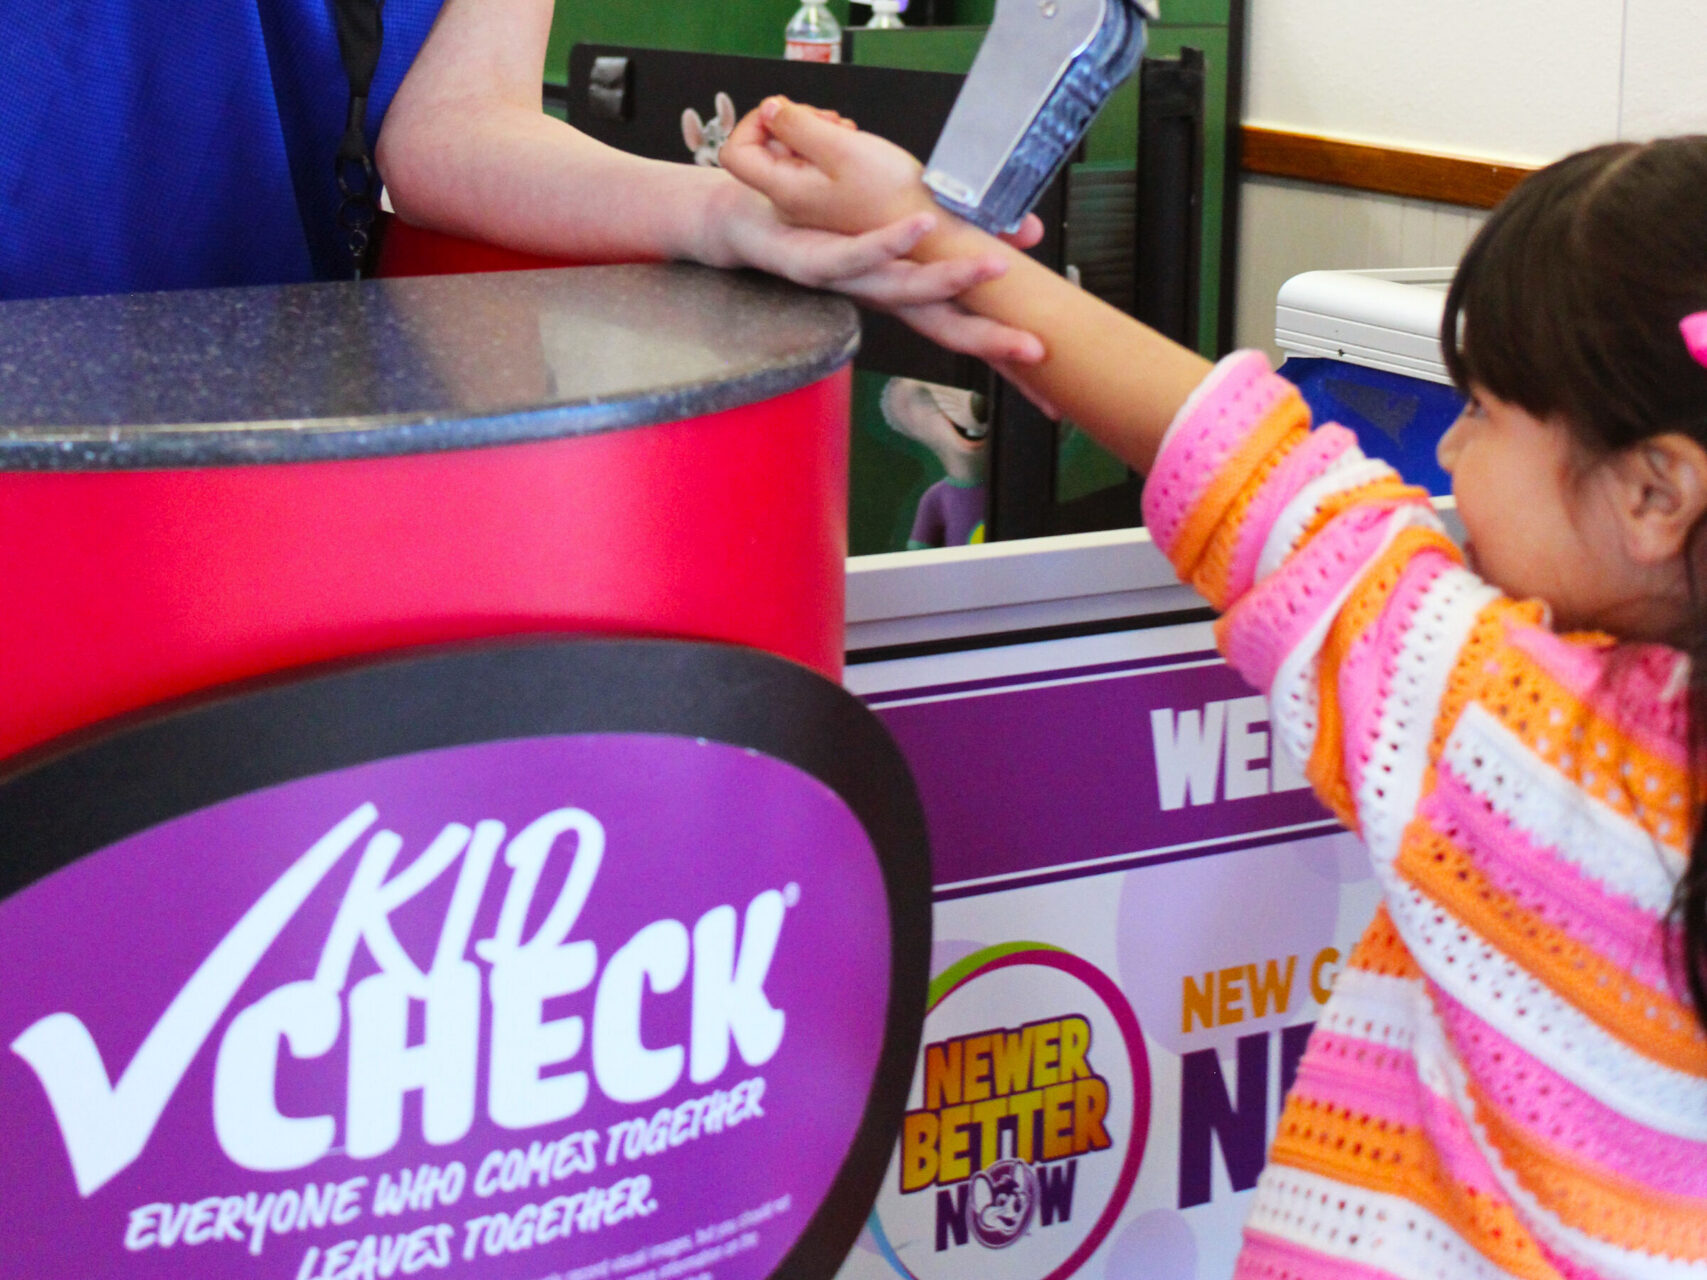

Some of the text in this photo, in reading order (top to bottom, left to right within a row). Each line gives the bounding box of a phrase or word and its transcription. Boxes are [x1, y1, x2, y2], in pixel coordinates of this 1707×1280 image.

[313, 806, 606, 992] KID
[212, 888, 785, 1172] CHECK
[1181, 954, 1298, 1034] NEW
[924, 1014, 1094, 1111] NEWER
[124, 1076, 767, 1256] EVERYONE WHO COMES TOGETHER
[900, 1074, 1113, 1195] BETTER
[294, 1222, 455, 1280] LEAVES
[462, 1174, 659, 1262] TOGETHER.
